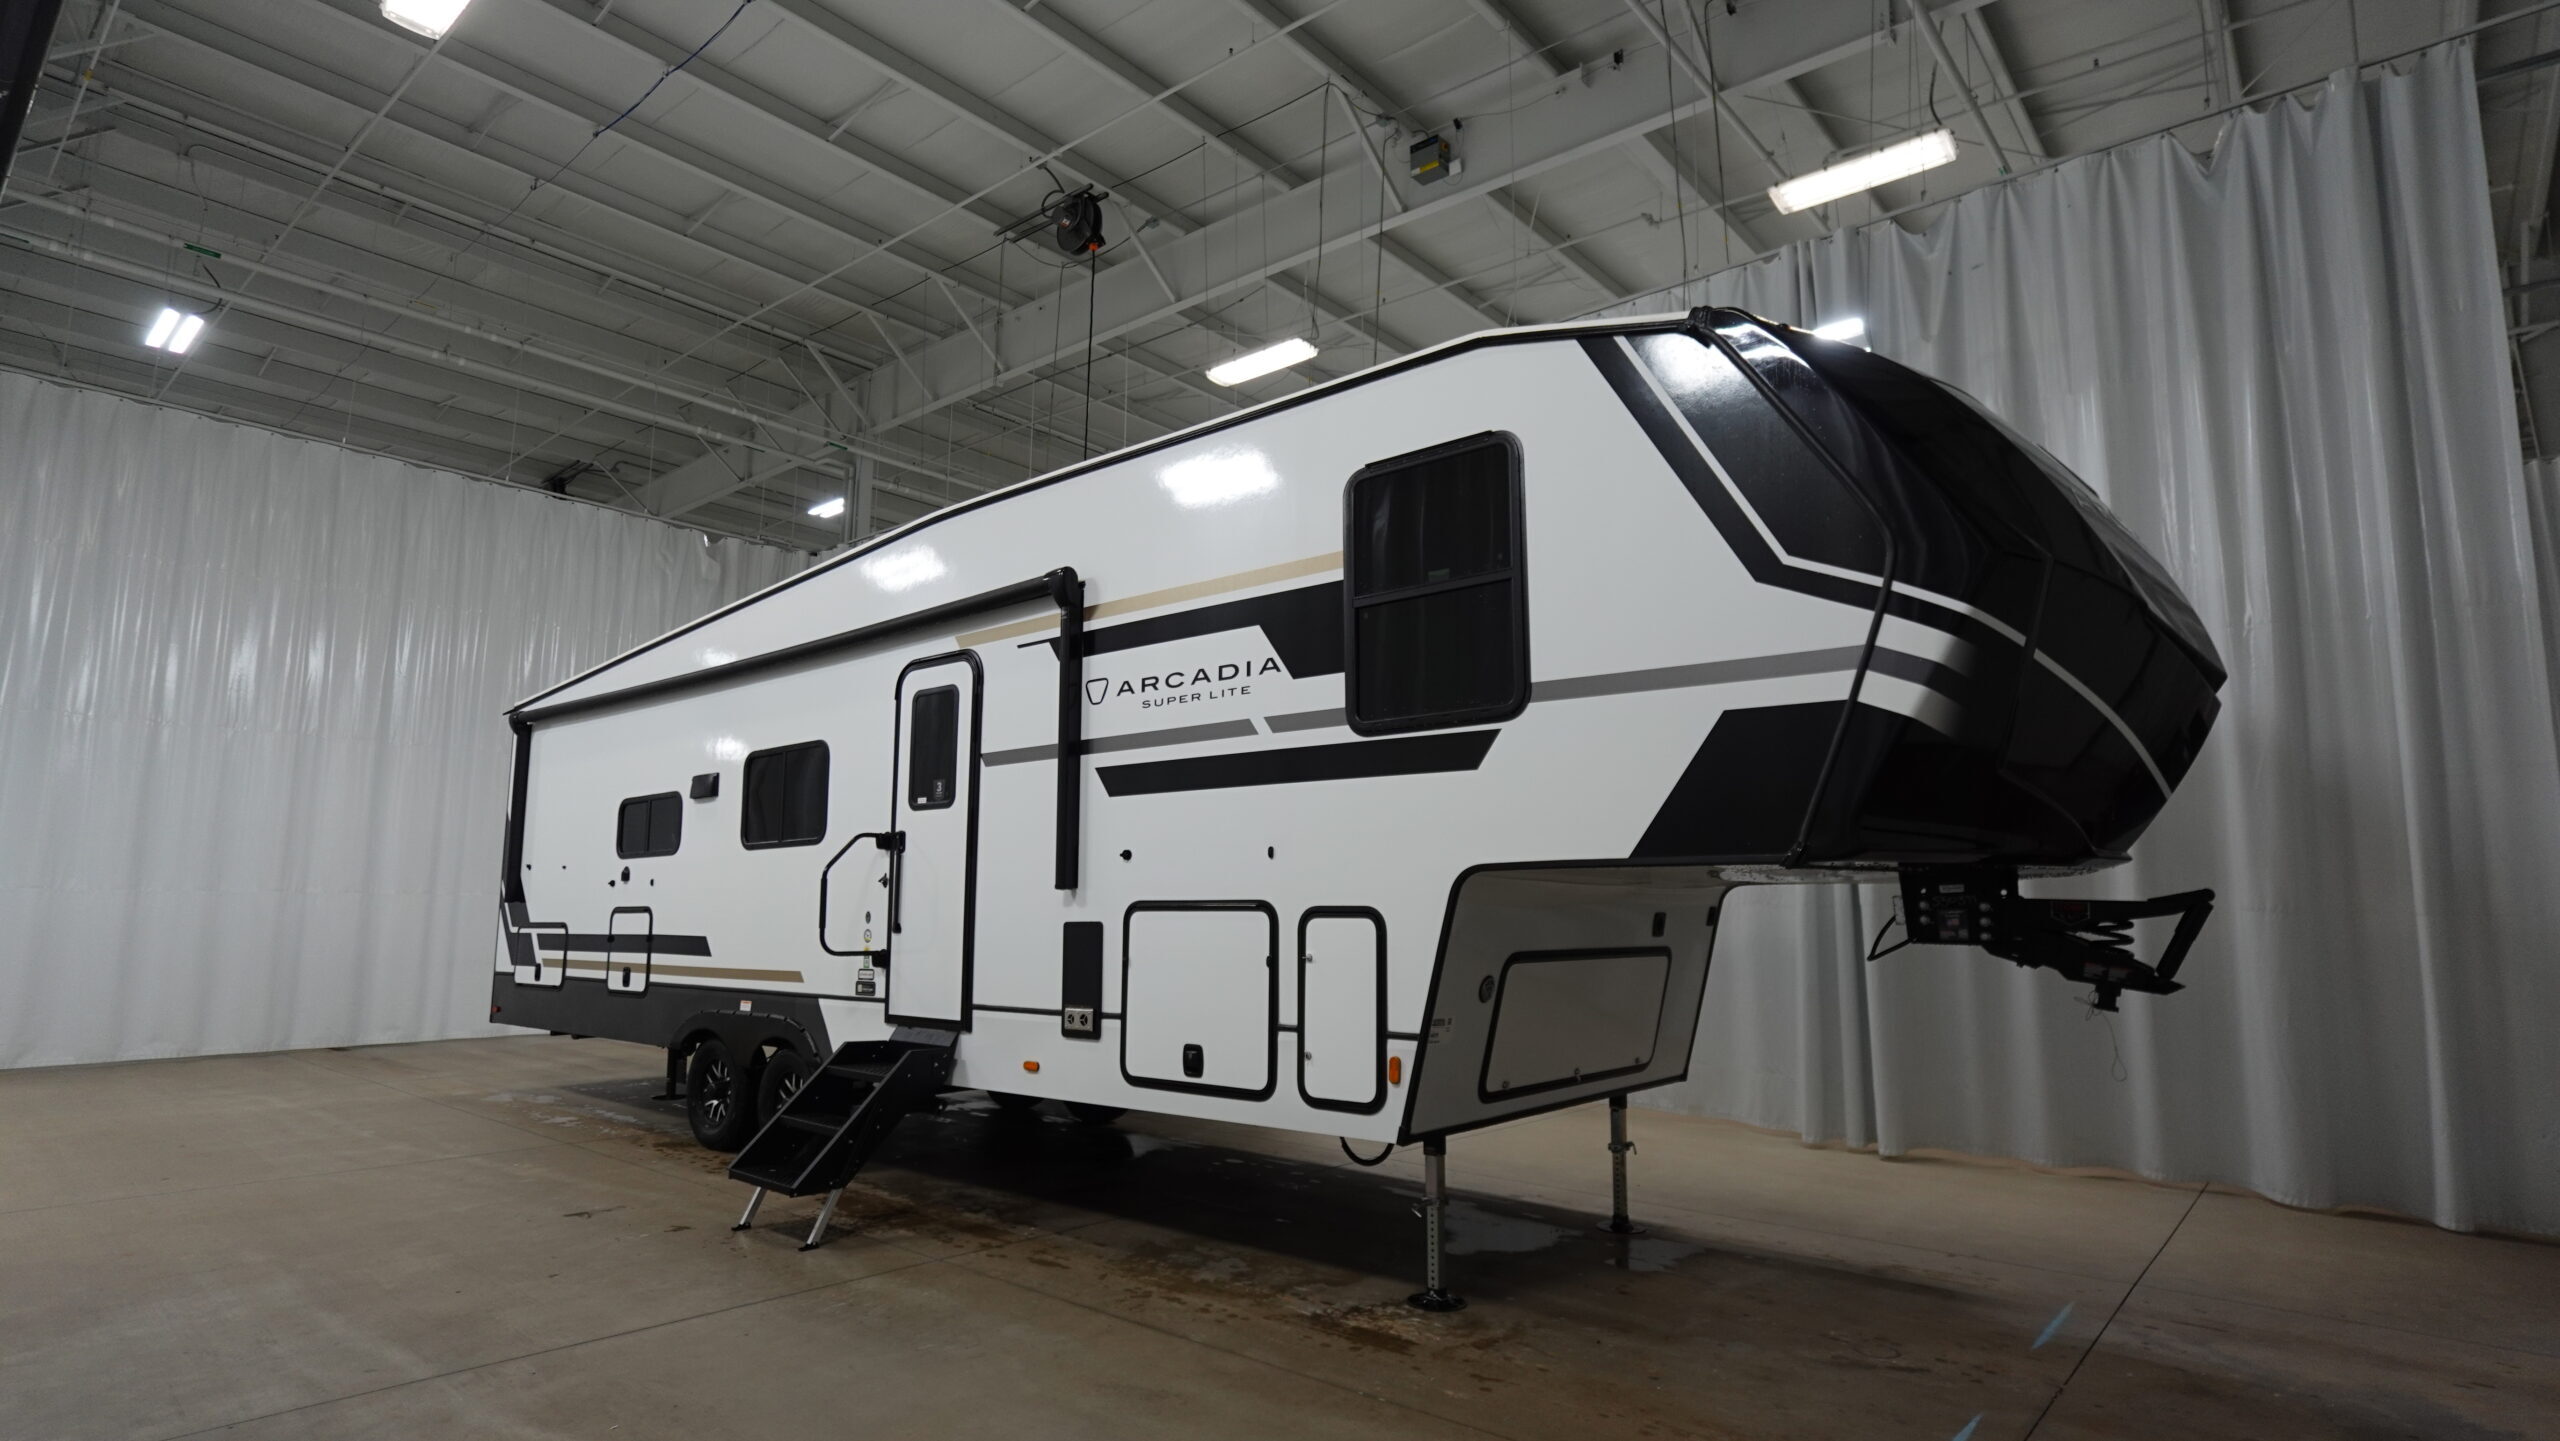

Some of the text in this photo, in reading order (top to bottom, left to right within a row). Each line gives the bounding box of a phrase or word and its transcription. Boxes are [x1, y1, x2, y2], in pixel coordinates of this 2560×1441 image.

[1116, 657, 1282, 697] ARCADIA
[1141, 685, 1252, 709] SUPER LITE
